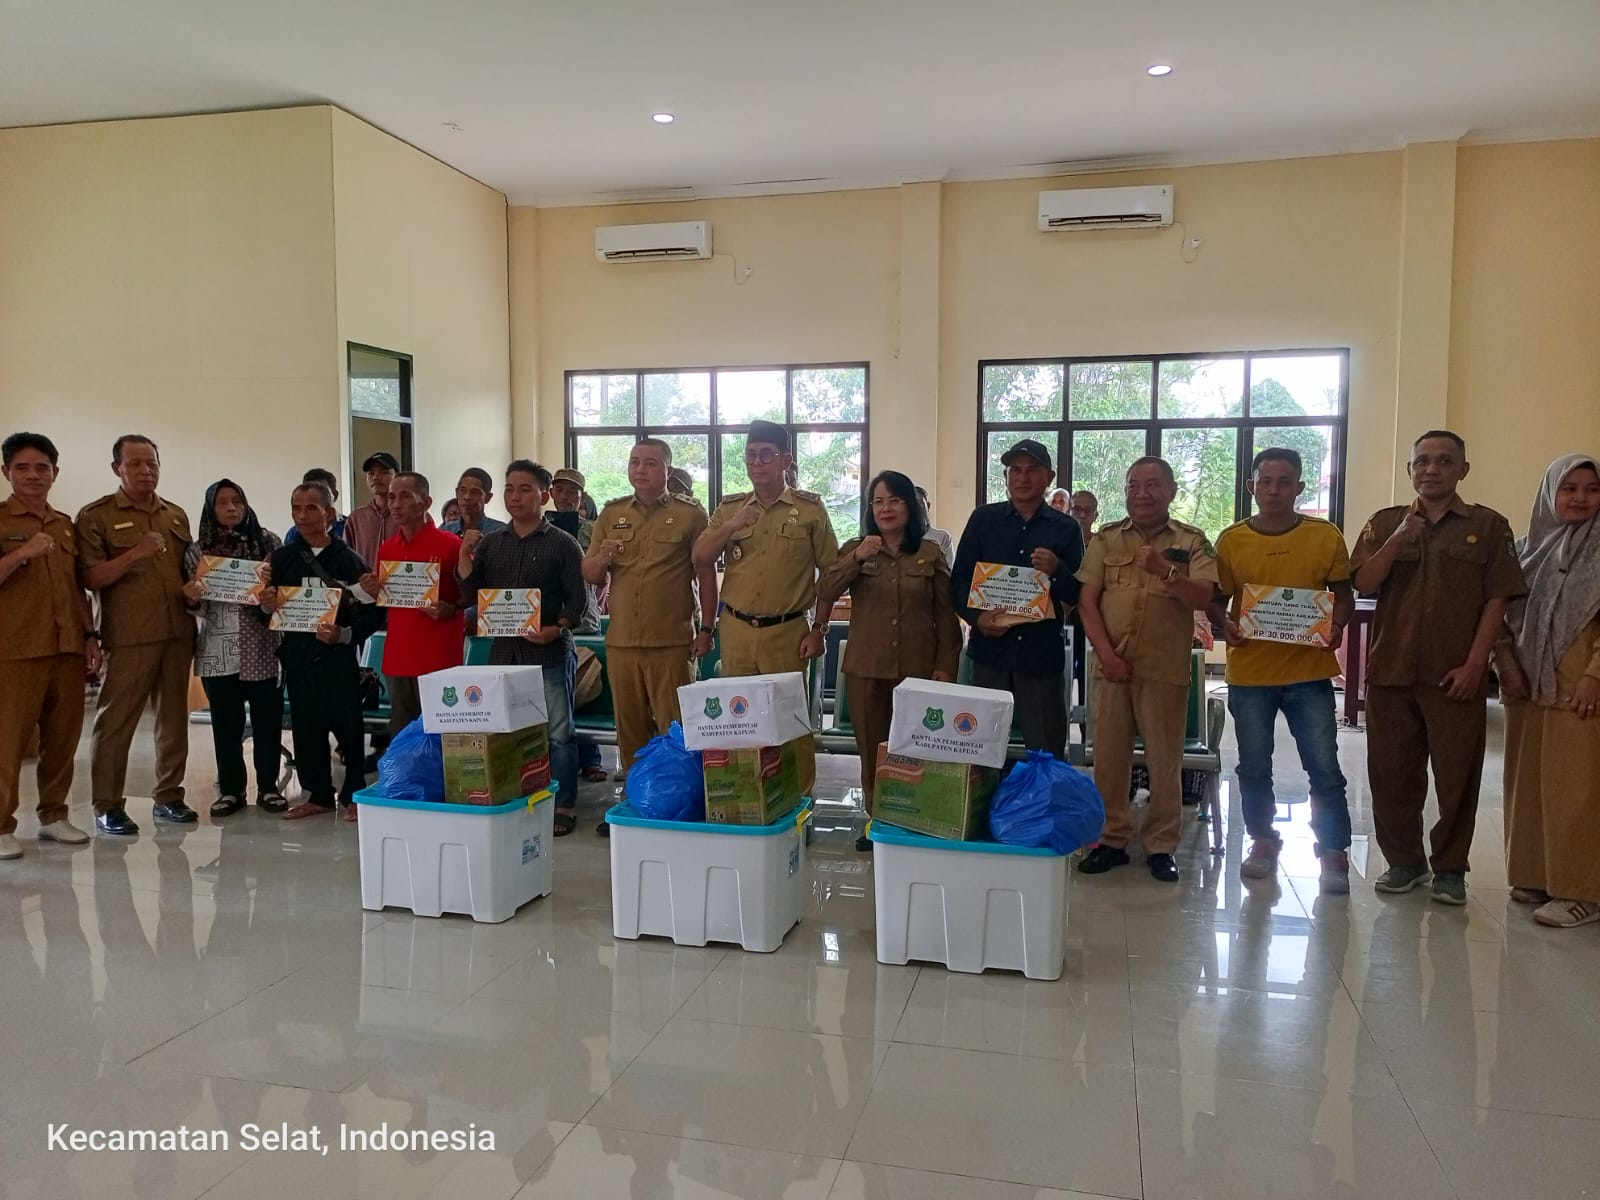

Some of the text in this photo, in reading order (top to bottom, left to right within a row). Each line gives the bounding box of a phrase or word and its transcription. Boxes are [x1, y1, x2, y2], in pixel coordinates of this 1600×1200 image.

[722, 722, 758, 730] PEMERINTAH
[911, 733, 984, 749] BANTUAN PEMERINTAH
[914, 741, 979, 755] KABUPATEN KAPUAS
